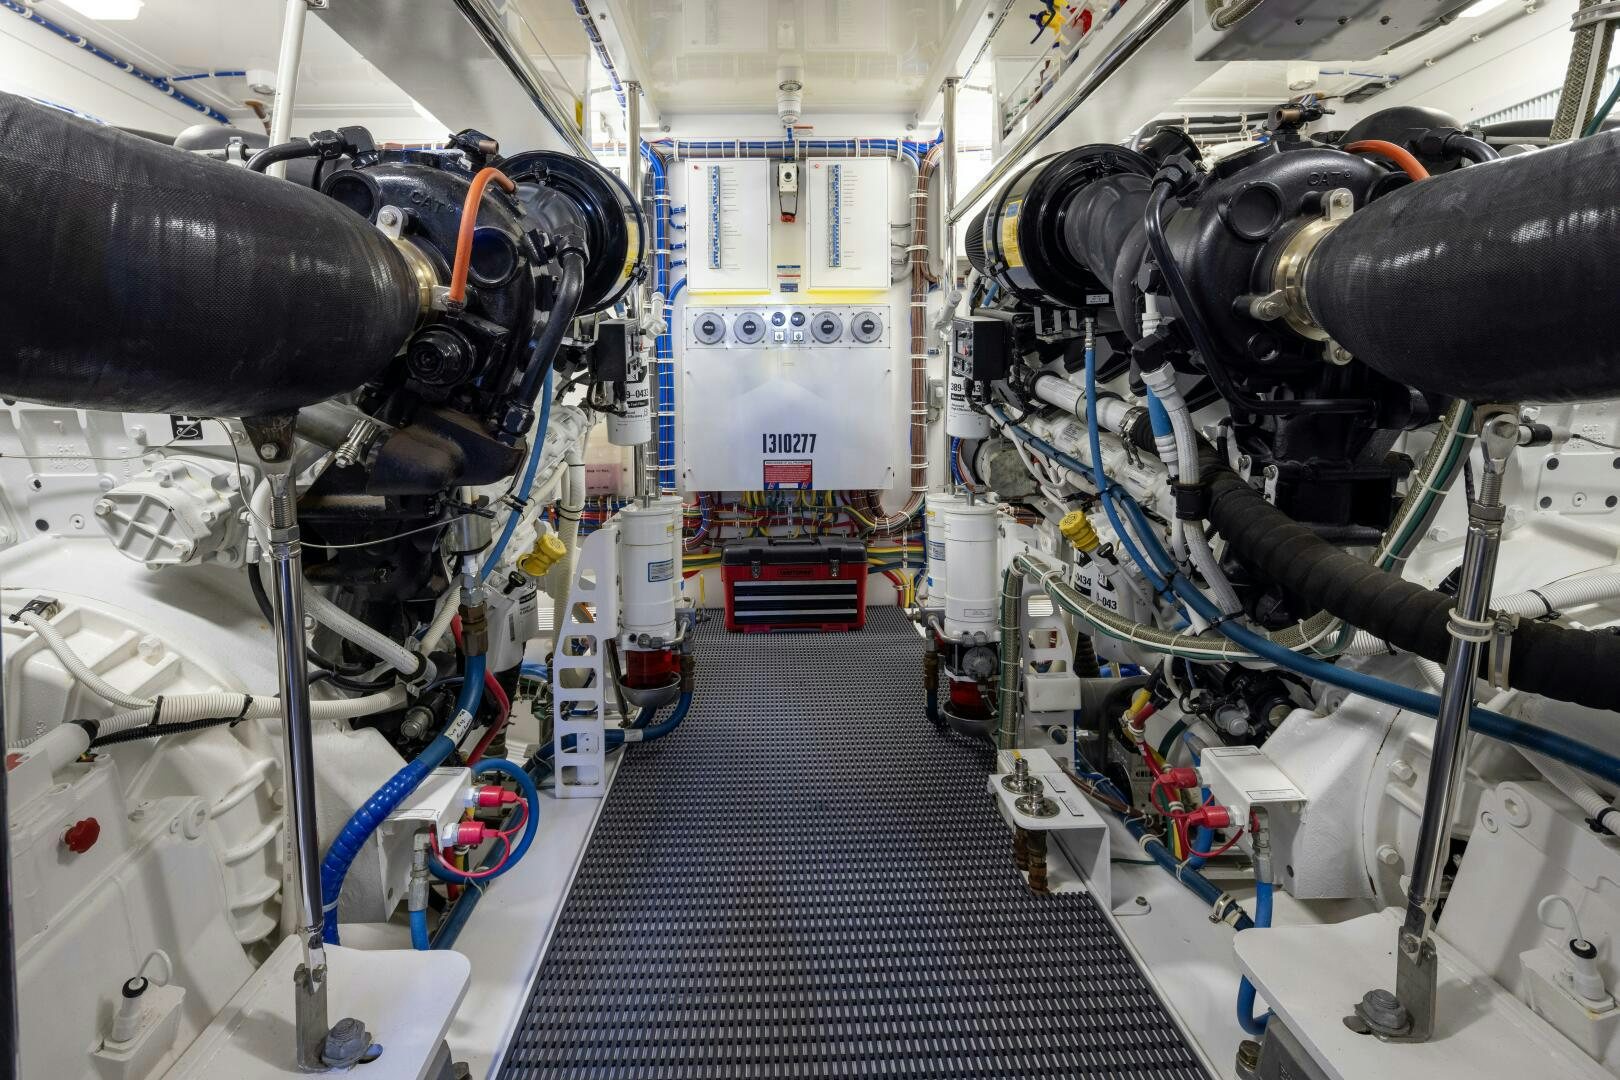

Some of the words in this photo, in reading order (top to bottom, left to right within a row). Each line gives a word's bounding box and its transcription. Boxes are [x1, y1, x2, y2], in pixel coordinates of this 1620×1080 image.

[1307, 171, 1342, 186] CAT
[409, 189, 446, 214] CAT
[762, 433, 817, 454] 1310277
